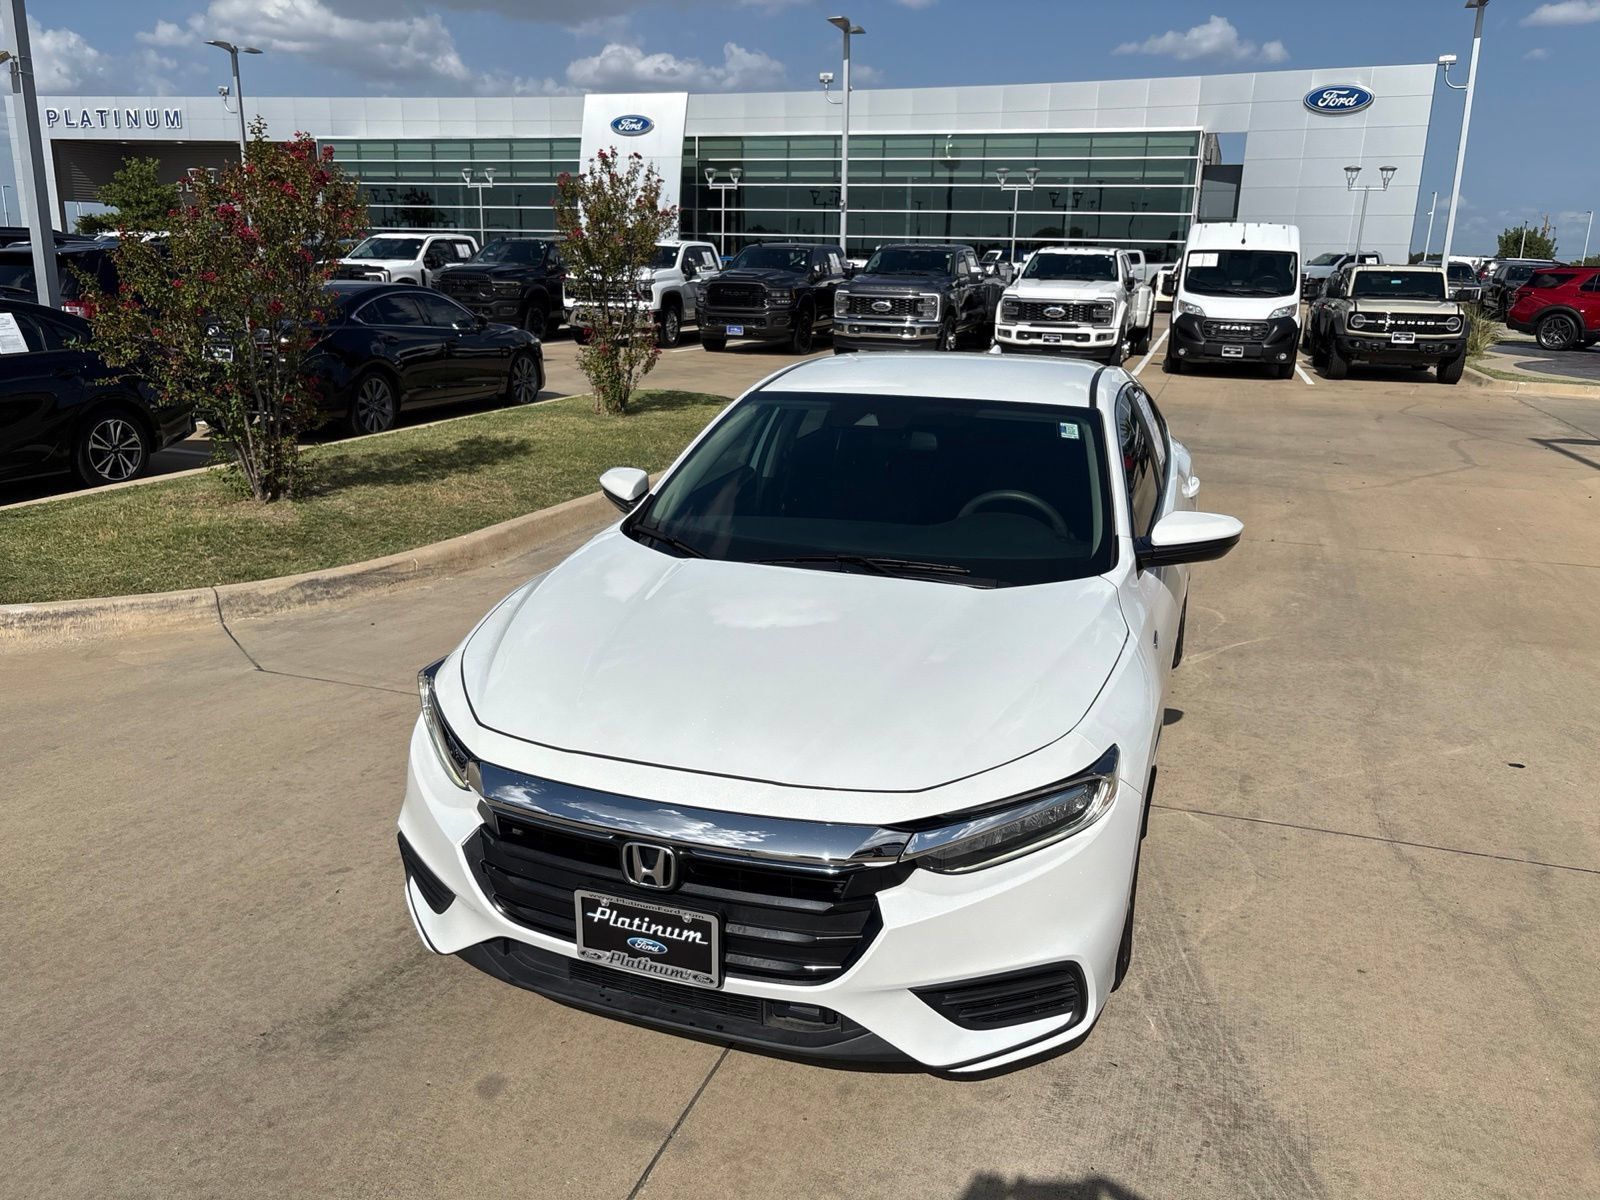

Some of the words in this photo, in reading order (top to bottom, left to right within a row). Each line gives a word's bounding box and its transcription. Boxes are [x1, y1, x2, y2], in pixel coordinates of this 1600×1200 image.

[1318, 90, 1359, 107] Ford
[45, 108, 182, 128] PLATINUM
[618, 118, 644, 131] Ford
[587, 906, 709, 945] Platinum
[633, 939, 660, 953] Ford
[606, 951, 689, 980] Platinum
